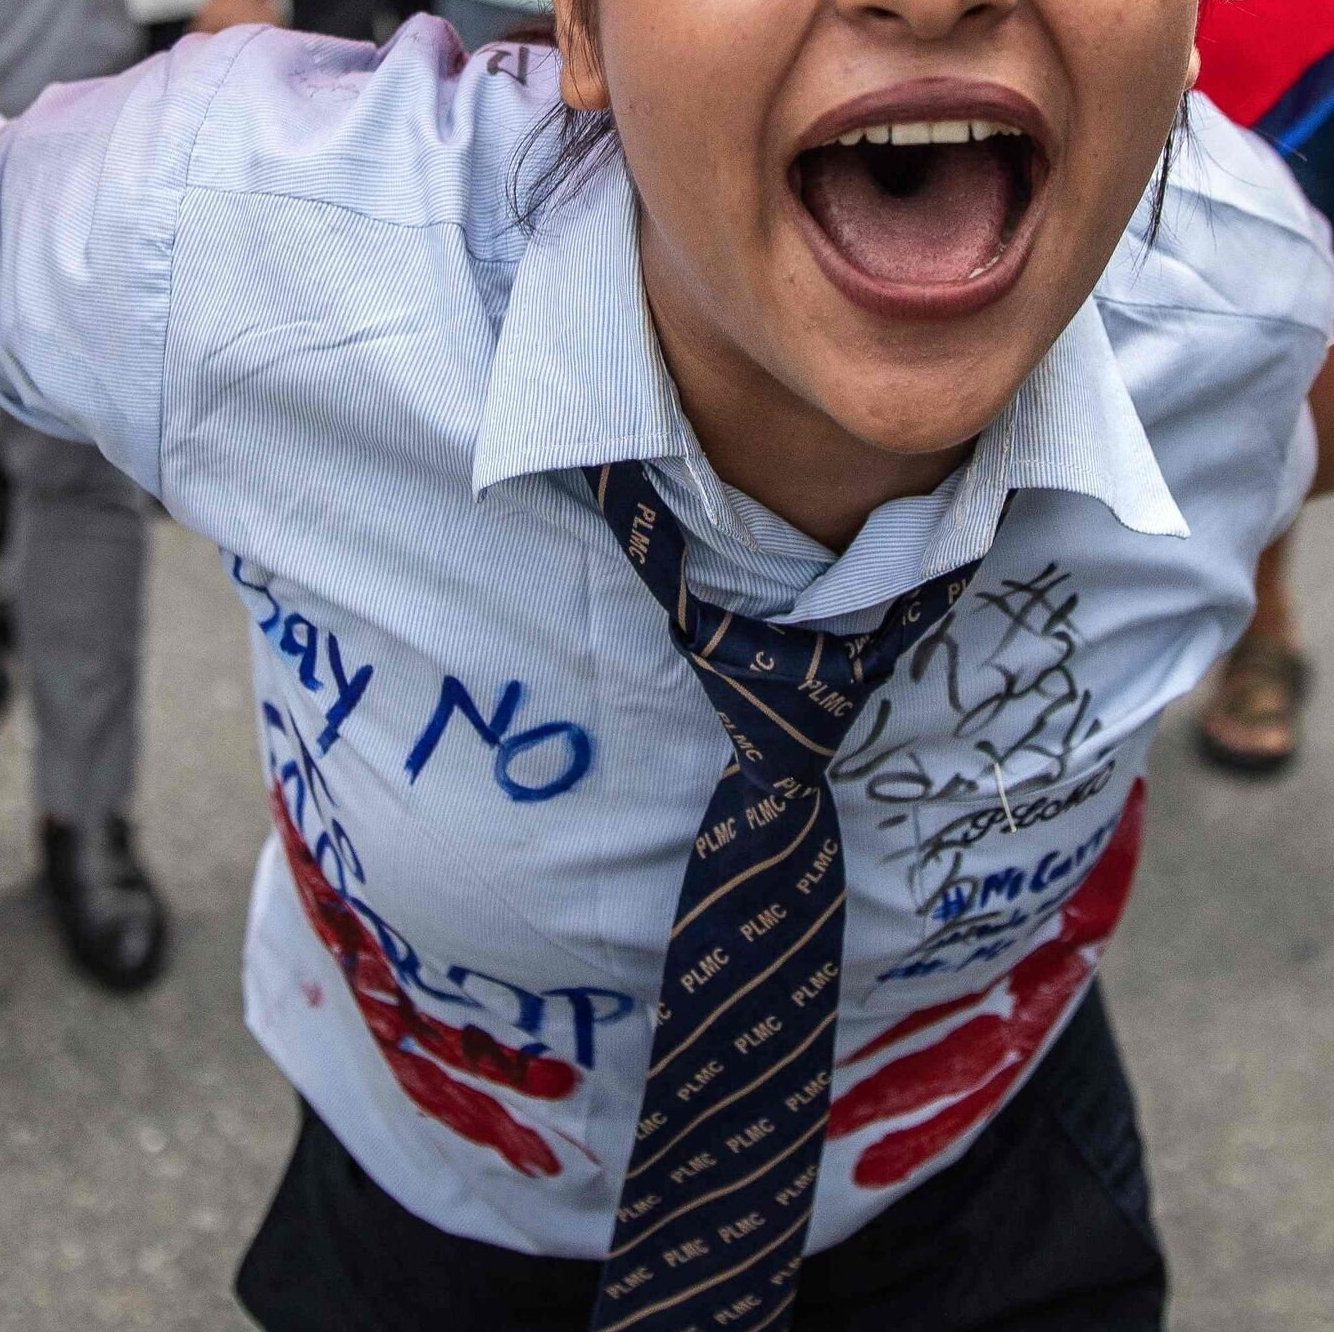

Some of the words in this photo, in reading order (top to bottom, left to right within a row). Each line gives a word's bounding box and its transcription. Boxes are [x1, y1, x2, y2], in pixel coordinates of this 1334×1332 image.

[629, 502, 656, 566] PLMC
[798, 678, 854, 718] PLMC
[405, 674, 593, 803] NO
[718, 711, 763, 763] PLMC
[695, 818, 737, 859] PLMC
[745, 795, 786, 829] PLMC
[680, 947, 730, 994] PLMC
[740, 903, 787, 942] PLMC
[797, 838, 838, 895] PLMC
[637, 1111, 668, 1141] LMC
[676, 1060, 725, 1101] PLMC
[734, 1016, 783, 1054] PLMC
[791, 962, 839, 1007] PLMC
[670, 1152, 718, 1184] PLMC
[725, 1119, 776, 1154] PLMC
[785, 1071, 831, 1112] PLMC
[605, 1268, 655, 1299] PLMC
[663, 1237, 710, 1267] PLMC
[718, 1212, 766, 1244] PLMC
[714, 1294, 763, 1325] PLMC
